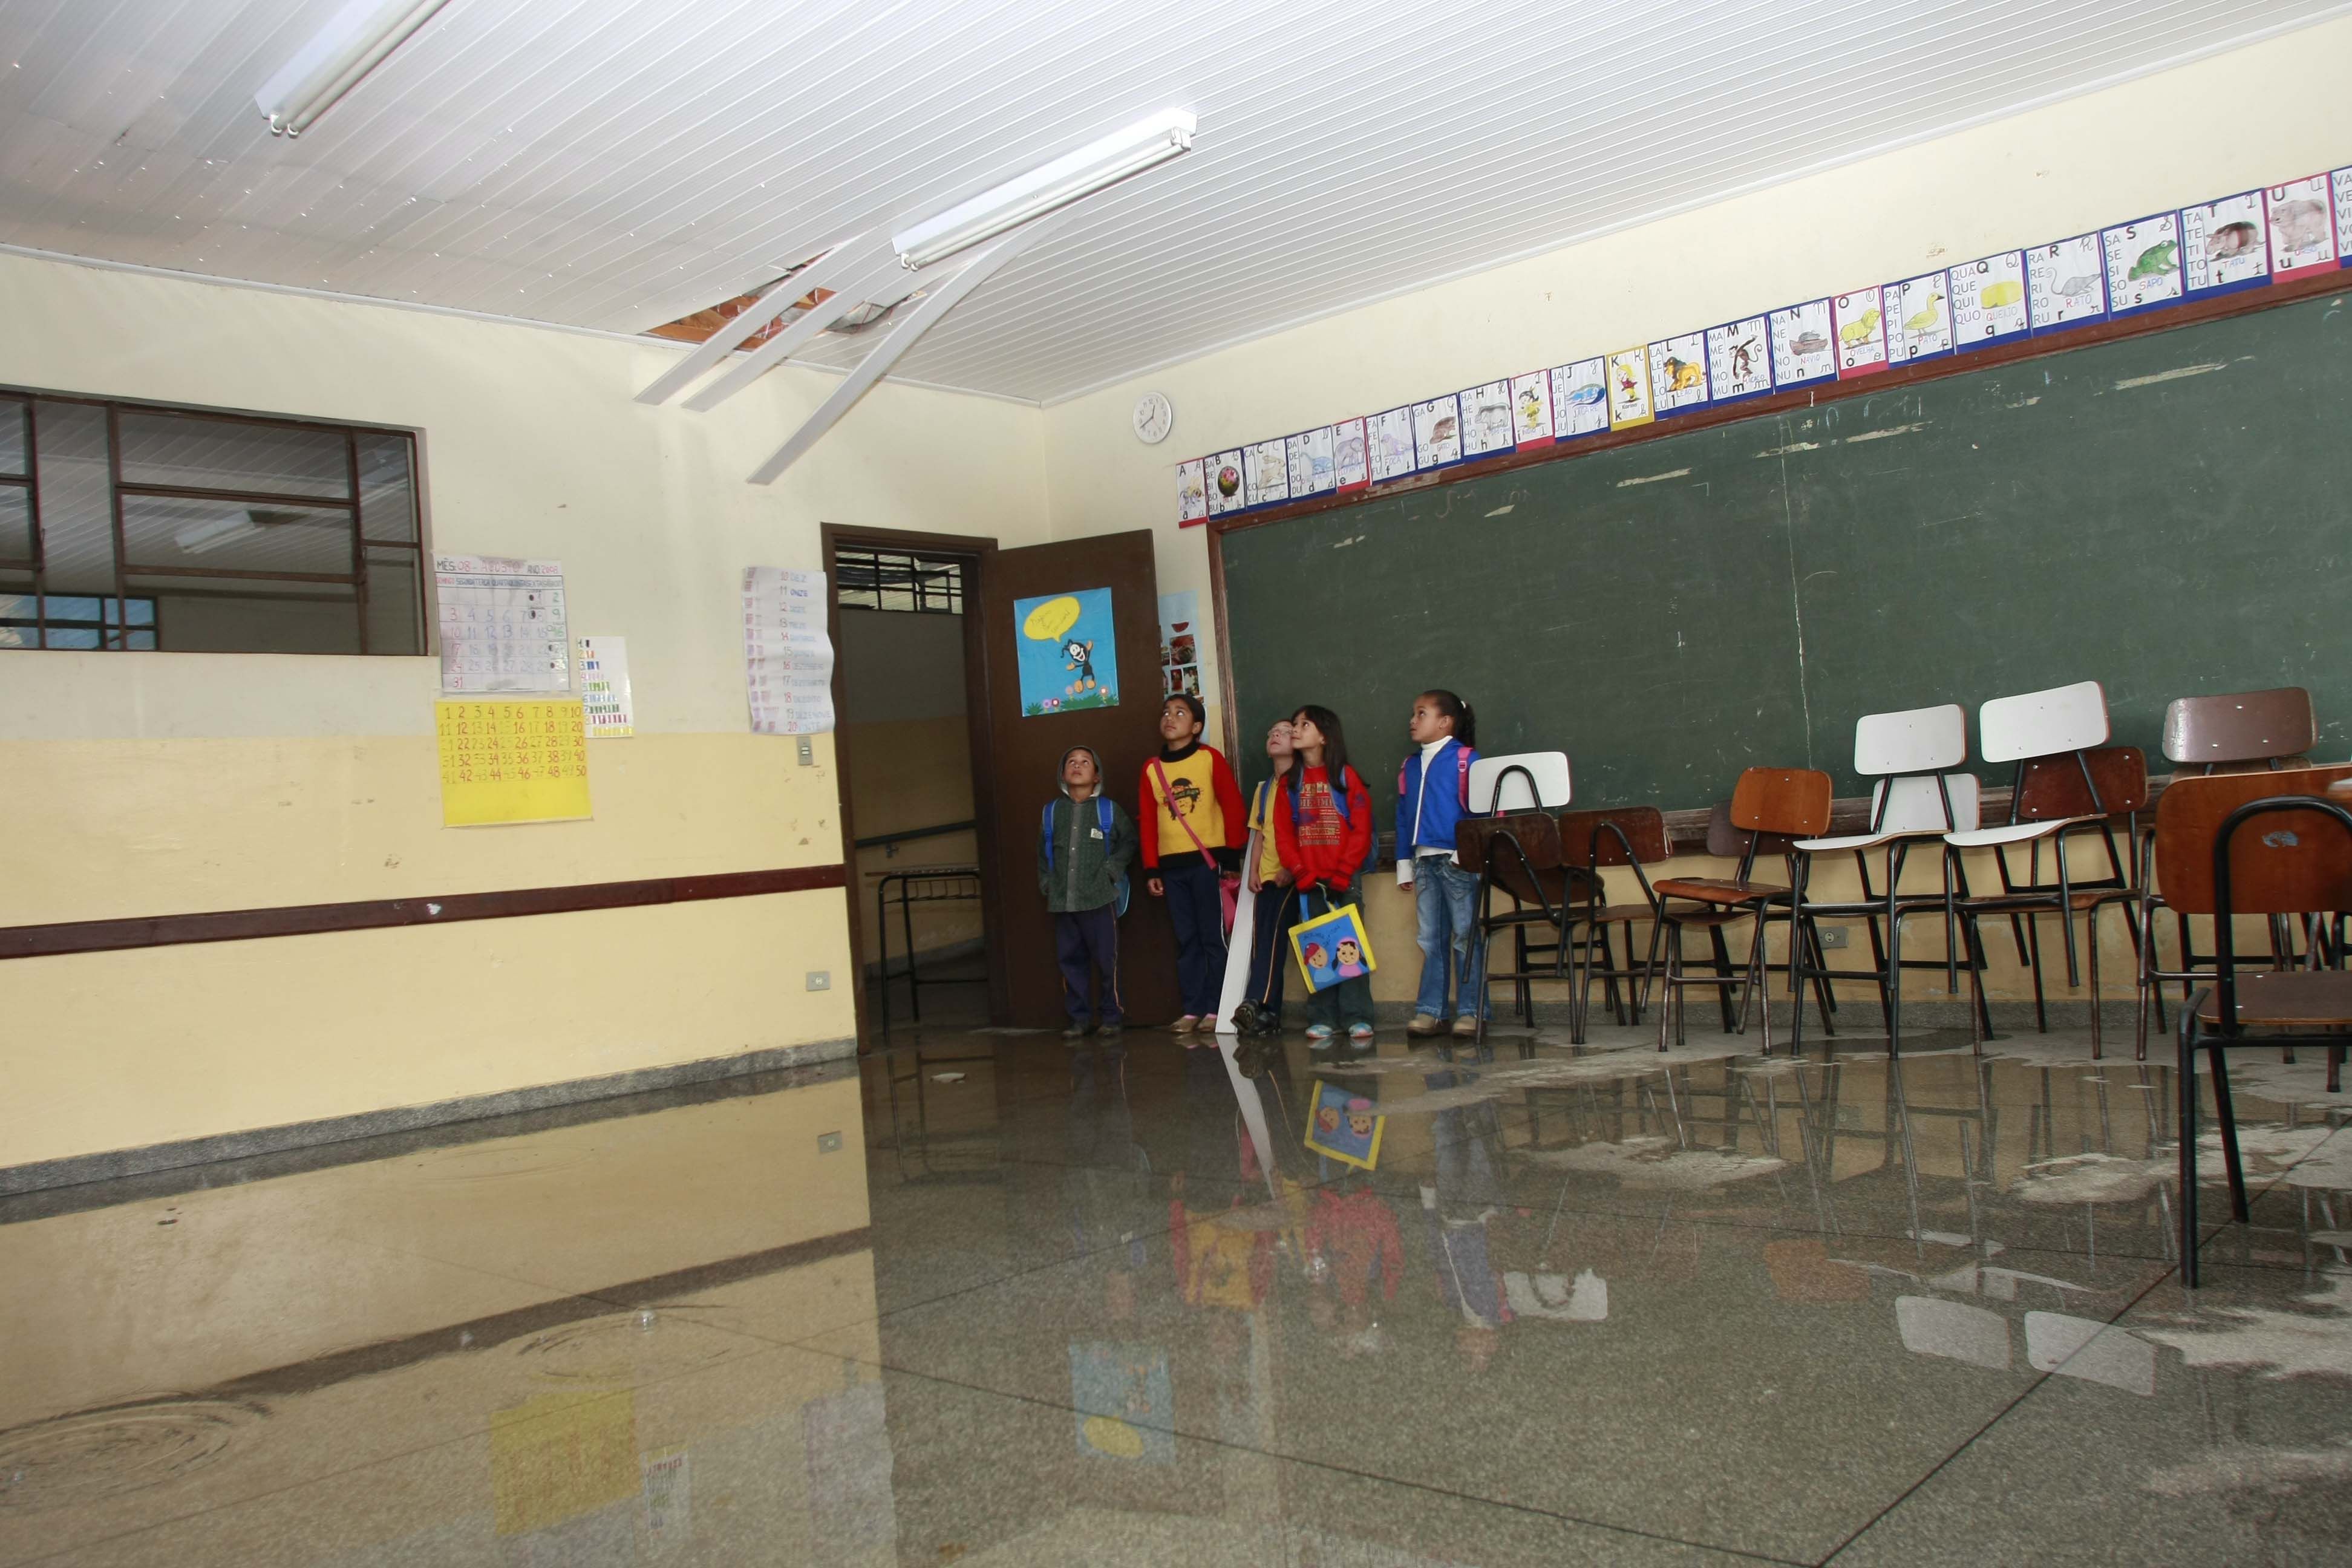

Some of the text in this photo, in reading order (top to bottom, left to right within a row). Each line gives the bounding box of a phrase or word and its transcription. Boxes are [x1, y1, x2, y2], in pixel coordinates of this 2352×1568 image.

[2272, 186, 2285, 201] U
[2208, 204, 2217, 218] T
[2184, 212, 2202, 224] TA
[2126, 226, 2137, 240] S
[2185, 228, 2203, 240] TE
[2105, 235, 2120, 247] SA
[2050, 246, 2059, 258] R
[2107, 250, 2122, 261] SE
[2186, 245, 2198, 256] TI
[2028, 254, 2044, 264] RA
[2279, 258, 2292, 269] u
[1977, 261, 1989, 274] Q
[2109, 266, 2119, 276] SI
[2187, 259, 2207, 272] TO
[1951, 267, 1976, 281] QUA
[2030, 269, 2044, 279] RE
[2216, 270, 2224, 283] t
[2111, 280, 2126, 292] SO
[2139, 277, 2163, 290] SAPO
[2188, 275, 2207, 286] TU
[1902, 284, 1910, 296] P
[1952, 281, 1976, 295] QUE
[2031, 285, 2042, 295] RI
[1885, 292, 1899, 301] PA
[2066, 295, 2092, 308] RATO
[2111, 295, 2128, 307] SU
[2134, 293, 2142, 304] s
[1838, 297, 1849, 309] O
[1953, 297, 1975, 310] QUI
[2033, 298, 2049, 310] RO
[1790, 308, 1800, 321] N
[1886, 304, 1900, 315] PE
[1772, 316, 1786, 326] NA
[1955, 310, 1981, 325] QUO
[2034, 313, 2050, 325] RU
[2057, 310, 2063, 321] r
[1887, 320, 1896, 330] PI
[1728, 324, 1739, 338] M
[1773, 329, 1786, 339] NE
[1986, 325, 1994, 337] q
[1709, 333, 1723, 342] MA
[1889, 333, 1903, 344] PO
[1918, 335, 1936, 345] PATO
[1667, 341, 1672, 351] L
[1710, 345, 1723, 356] ME
[1774, 343, 1784, 353] NI
[1909, 345, 1918, 358] p
[1650, 348, 1662, 358] LA
[1889, 348, 1904, 358] PU
[1612, 356, 1619, 367] K
[1651, 360, 1662, 370] LE
[1711, 359, 1722, 370] MI
[1775, 357, 1790, 367] NO
[1801, 354, 1820, 365] NAVIO
[1846, 358, 1854, 367] o
[1552, 373, 1563, 381] JA
[1567, 367, 1572, 378] J
[1713, 371, 1728, 382] MO
[1777, 371, 1791, 381] NU
[1797, 368, 1805, 378] n
[1653, 374, 1661, 384] LI
[1476, 388, 1484, 399] H
[1553, 384, 1562, 393] JE
[1655, 387, 1666, 397] LO
[1713, 385, 1728, 396] MU
[1733, 383, 1744, 393] m
[1461, 393, 1472, 402] HA
[1427, 402, 1434, 412] G
[1463, 405, 1473, 414] HE
[1655, 400, 1667, 410] LU
[1414, 408, 1425, 417] GA
[1555, 410, 1566, 419] JO
[1616, 410, 1622, 421] k
[1382, 416, 1385, 426] F
[1463, 418, 1471, 426] HI
[1573, 420, 1575, 433] j
[1336, 426, 1341, 436] E
[1518, 431, 1520, 441] i
[1303, 436, 1310, 445] D
[1481, 440, 1488, 450] h
[1257, 444, 1263, 453] C
[1417, 443, 1428, 452] GO
[1465, 442, 1477, 451] HU
[1215, 455, 1221, 465] B
[1417, 455, 1429, 465] GU
[1432, 454, 1438, 465] g
[1180, 465, 1186, 476] A
[1386, 466, 1390, 475] f
[1309, 482, 1315, 492] d
[1220, 503, 1224, 512] b
[457, 561, 471, 572] 08
[554, 592, 560, 603] 2
[450, 607, 561, 621] 3 4 5 9
[485, 626, 497, 639] 12
[453, 677, 463, 687] 31
[446, 706, 581, 719] 1 2 3 4 5 6 7 8 9 10
[457, 720, 582, 734] 12 14 16 18 20
[457, 736, 584, 750] 22 24 26 28 30
[459, 750, 585, 766] 32 34 36 38 40
[459, 765, 587, 782] 42 44 46 48 50
